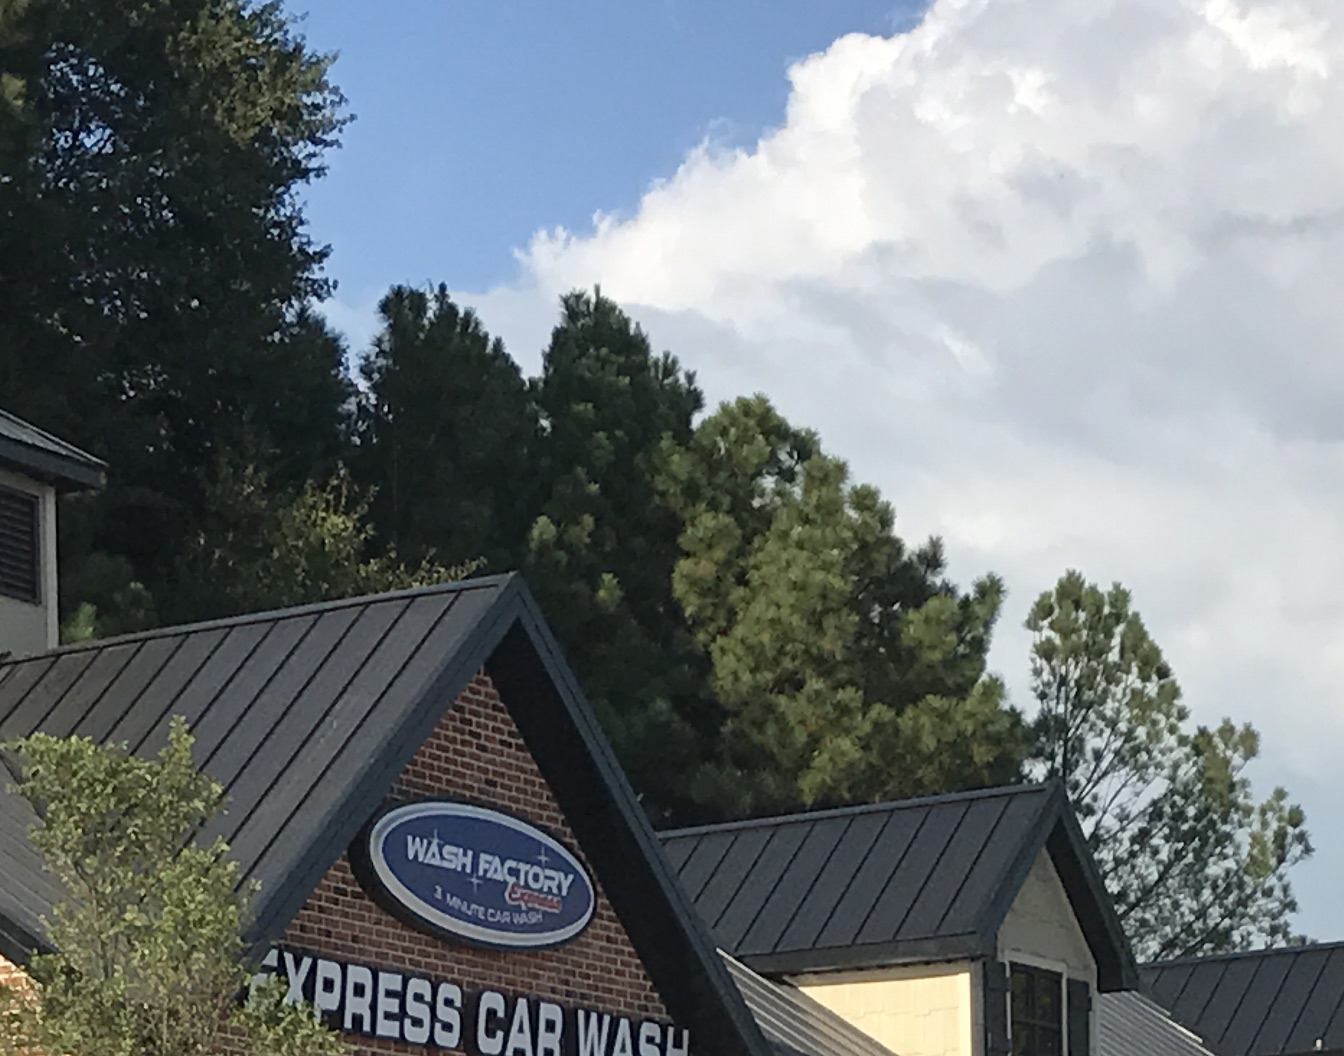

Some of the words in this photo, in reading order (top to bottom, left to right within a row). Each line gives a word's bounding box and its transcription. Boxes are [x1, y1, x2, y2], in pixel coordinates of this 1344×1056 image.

[407, 835, 473, 873] WASH
[479, 852, 574, 896] FACTORY
[446, 893, 485, 919] MINUTE
[487, 905, 511, 923] CAR
[512, 910, 543, 924] WASH
